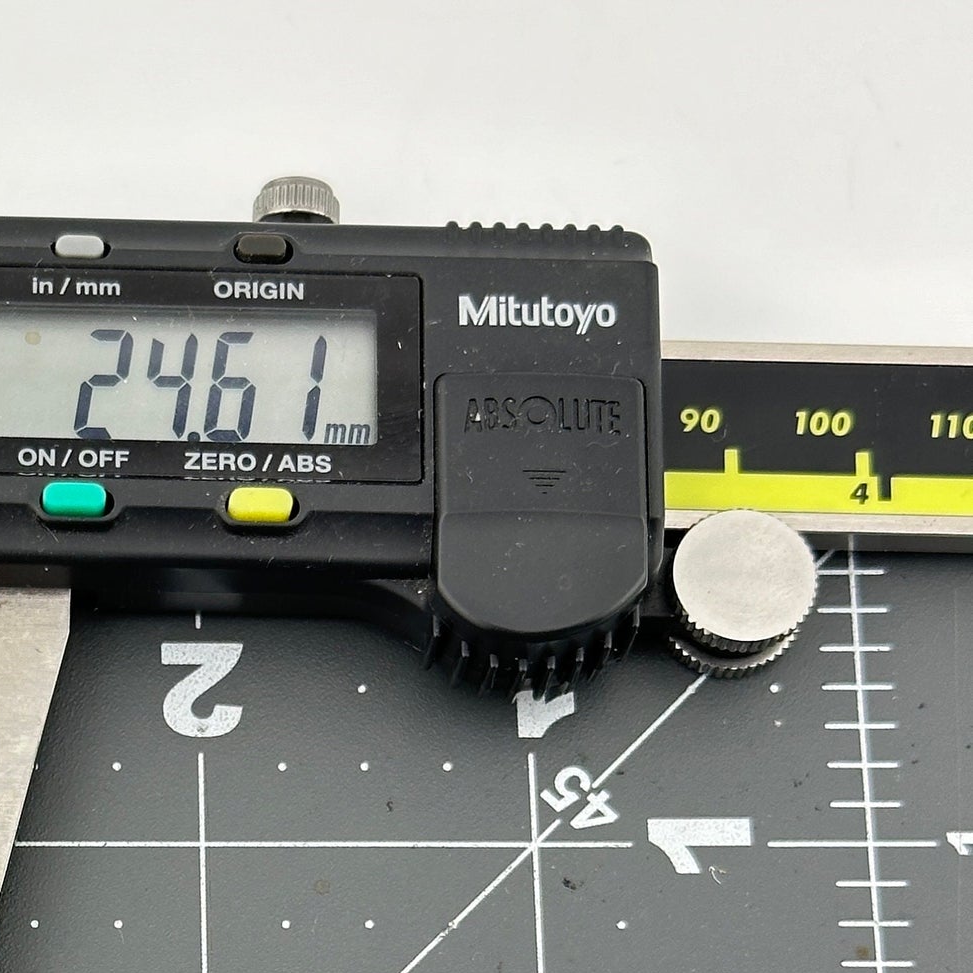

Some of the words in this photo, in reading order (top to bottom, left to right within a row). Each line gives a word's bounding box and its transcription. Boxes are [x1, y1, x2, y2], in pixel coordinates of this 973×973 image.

[31, 277, 55, 295] in
[75, 279, 122, 296] mm
[213, 281, 305, 301] ORIGIN
[457, 294, 617, 335] Mitutoyo
[73, 329, 327, 443] 24.61
[324, 422, 371, 445] mm
[464, 395, 621, 436] ABSOLUTE
[679, 408, 721, 434] 90
[794, 410, 852, 436] 100
[17, 449, 56, 468] ON
[78, 450, 130, 469] OFF
[183, 452, 256, 472] ZERO
[277, 453, 333, 473] ABS
[849, 482, 869, 505] 4
[160, 642, 244, 738] 2
[539, 766, 619, 829] 45
[646, 817, 753, 875] 1
